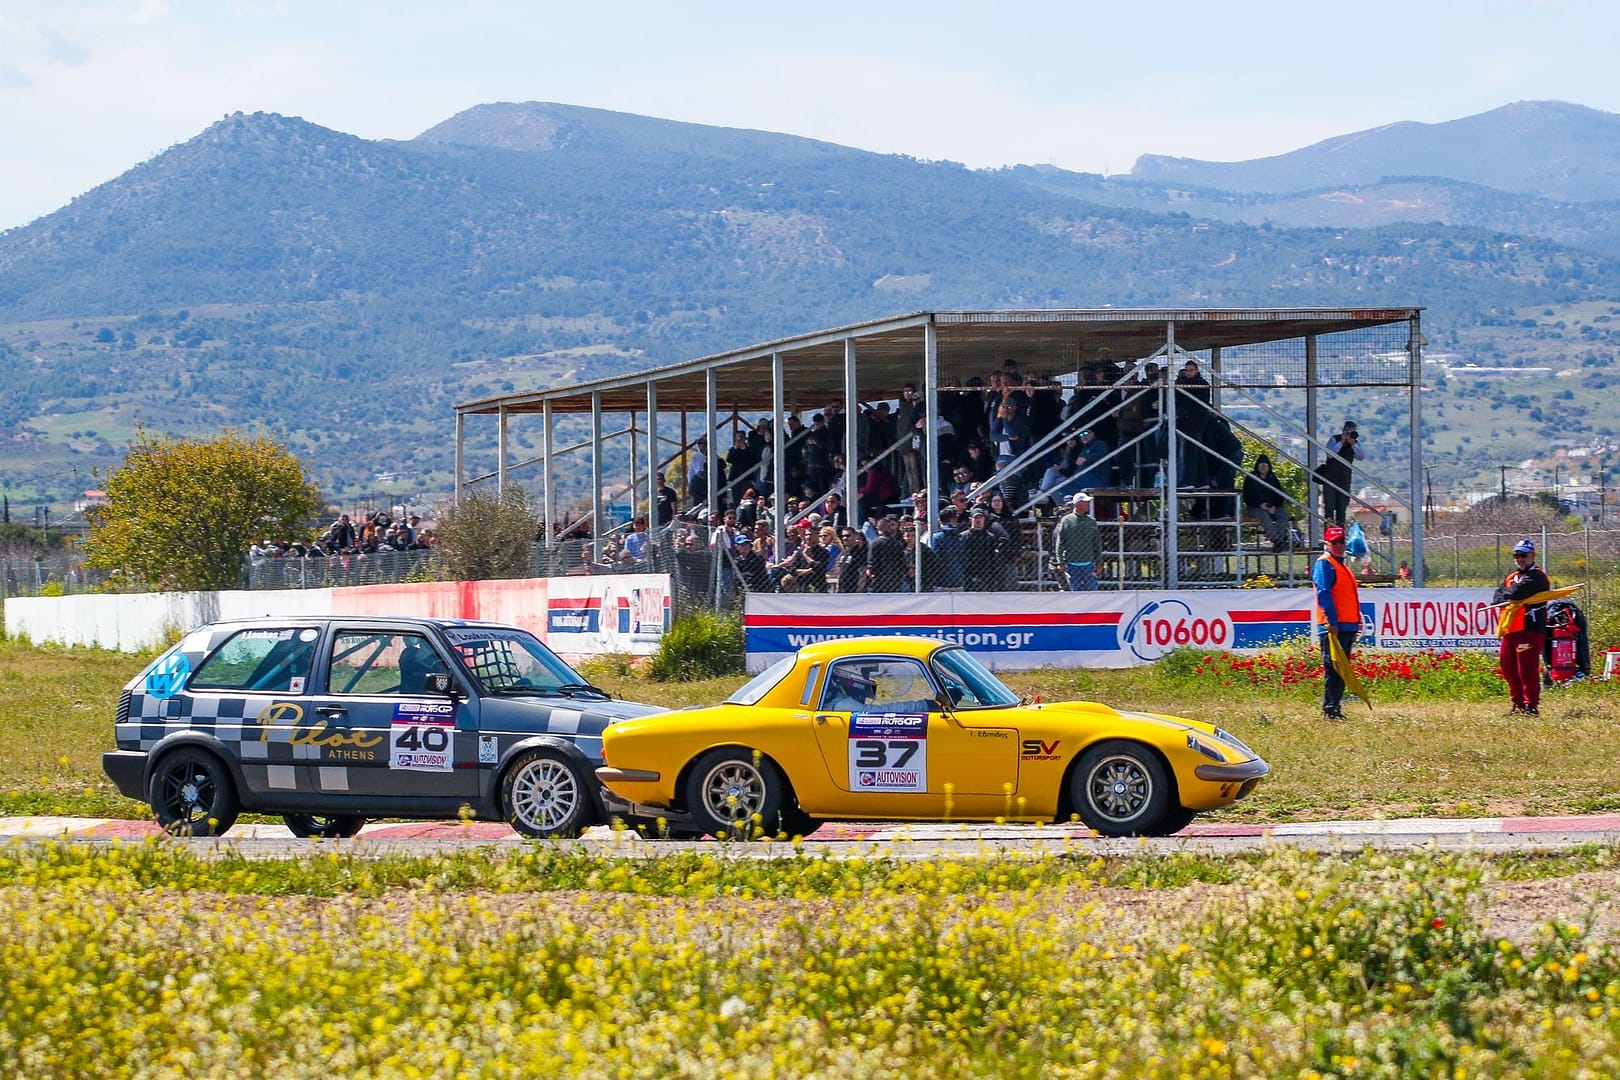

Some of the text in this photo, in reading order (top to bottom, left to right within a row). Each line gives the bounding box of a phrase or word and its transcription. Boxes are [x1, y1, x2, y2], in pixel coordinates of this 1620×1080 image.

[1381, 601, 1502, 636] AUTOVISION
[1142, 618, 1227, 646] 10600
[395, 726, 449, 752] 40
[1022, 739, 1062, 755] SV
[329, 750, 375, 760] ATHENS
[413, 754, 447, 765] AUTOVISION
[856, 741, 919, 768] 37
[877, 772, 917, 783] AUTOVISION
